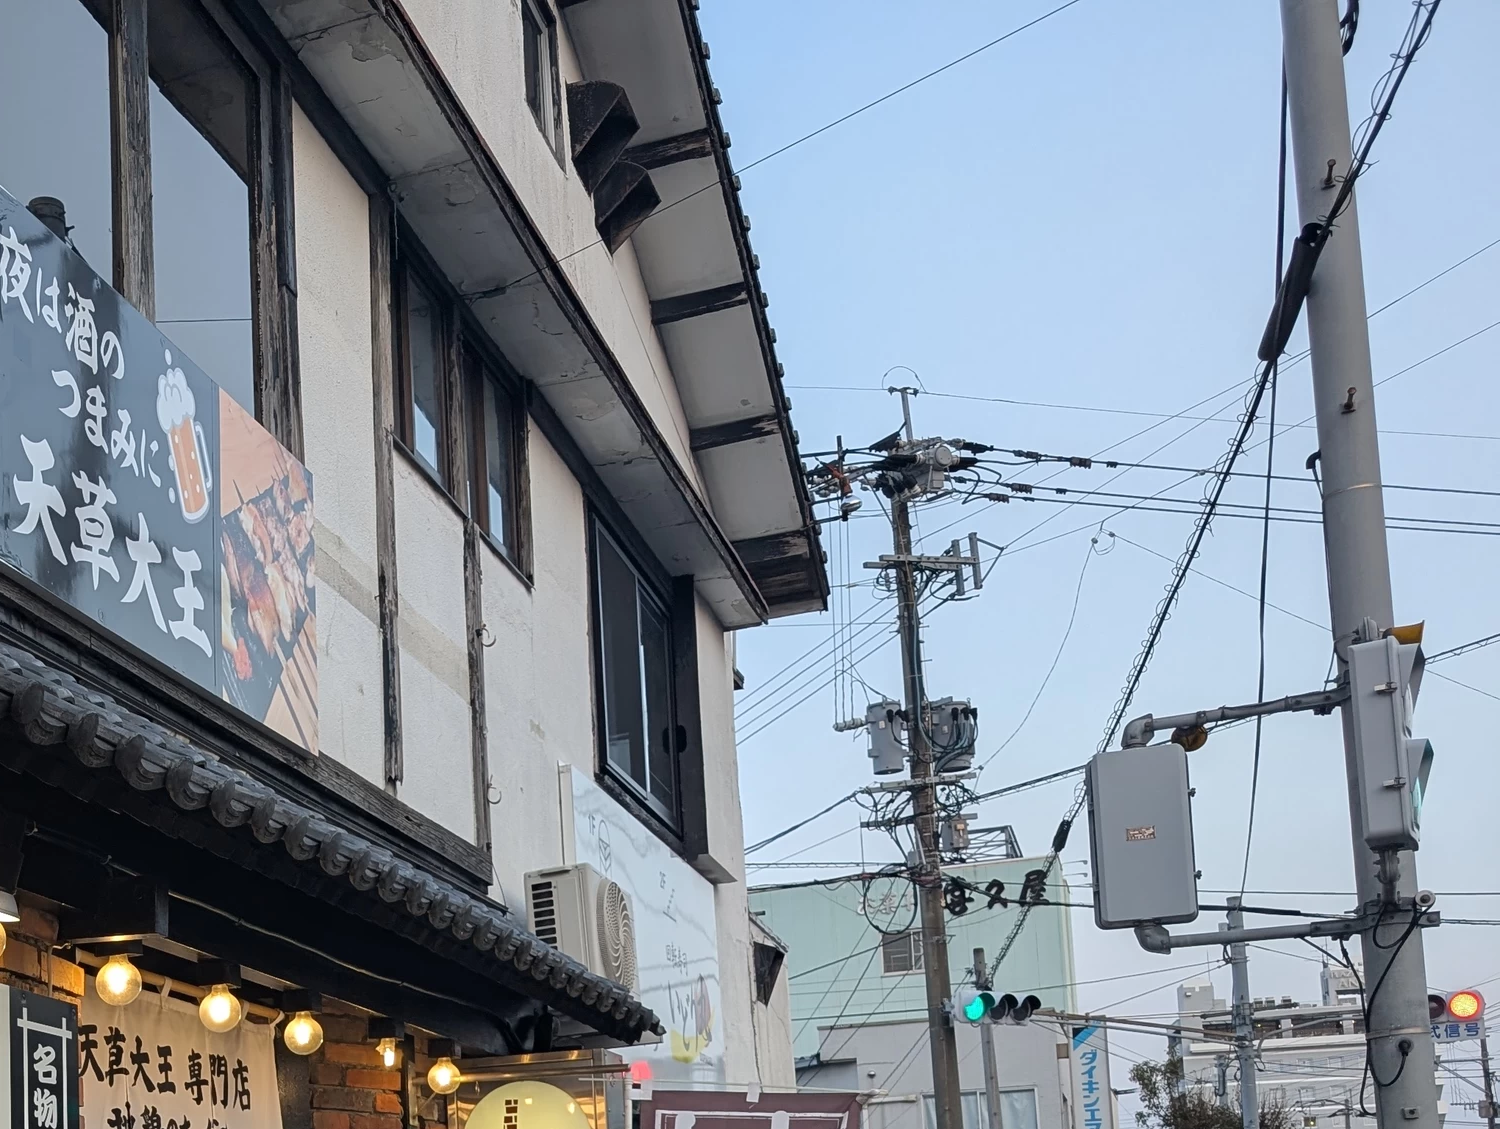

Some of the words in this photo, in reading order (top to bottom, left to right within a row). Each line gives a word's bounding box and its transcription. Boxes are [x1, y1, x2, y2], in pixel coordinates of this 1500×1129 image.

[52, 369, 162, 489] つまみに
[12, 434, 212, 658] 天草大王
[78, 1024, 177, 1095] 天草大王
[184, 1049, 250, 1111] 専門店
